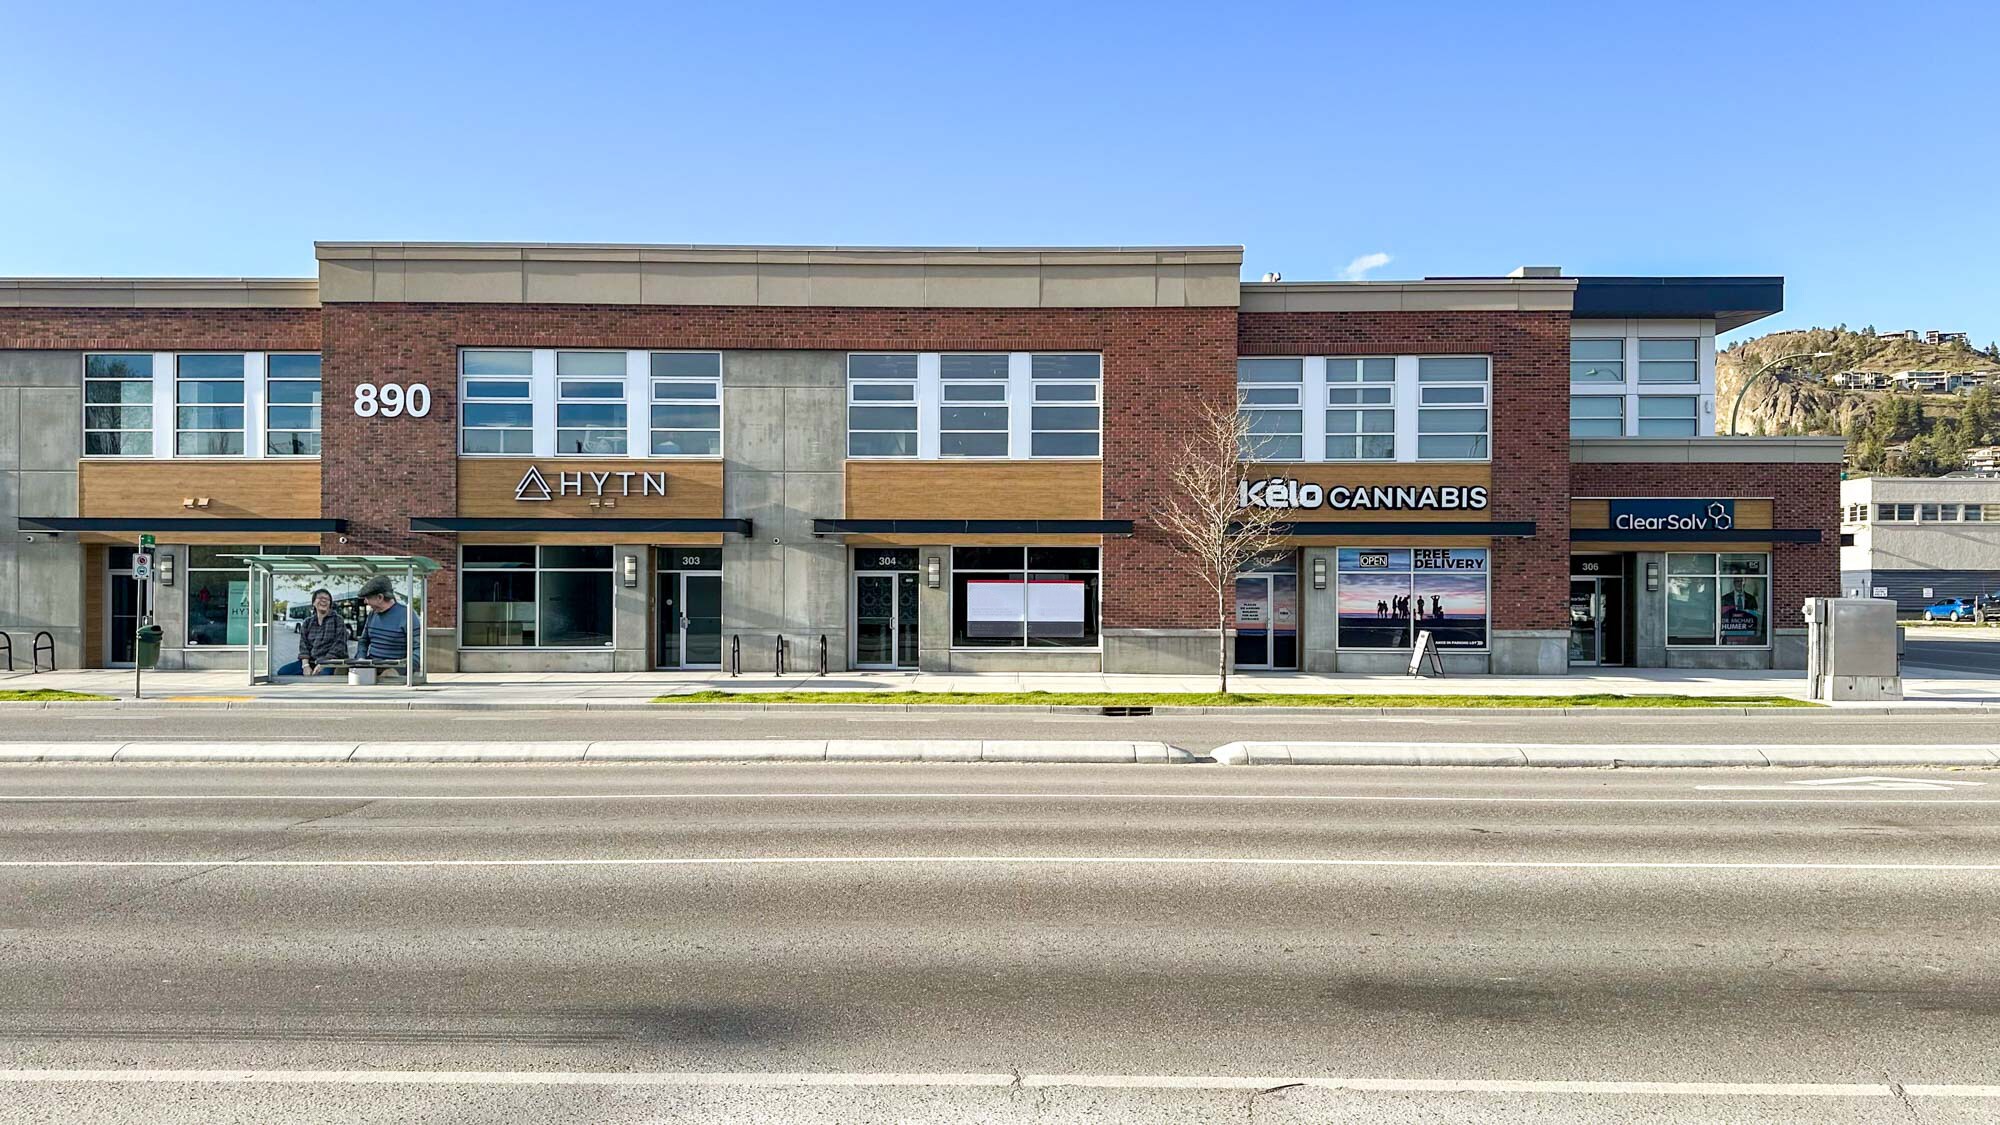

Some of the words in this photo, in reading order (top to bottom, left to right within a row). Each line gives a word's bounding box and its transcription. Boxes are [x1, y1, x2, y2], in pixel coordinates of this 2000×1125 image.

[353, 383, 431, 418] 890
[560, 471, 666, 497] HYTN
[1329, 487, 1488, 509] CANNABIS
[1615, 514, 1708, 530] ClearSolv
[1414, 549, 1450, 559] FREE
[682, 556, 701, 566] 303
[878, 556, 897, 566] 304
[1362, 556, 1386, 566] OPEN
[1414, 559, 1484, 569] DELIVERY
[1582, 562, 1599, 571] 306
